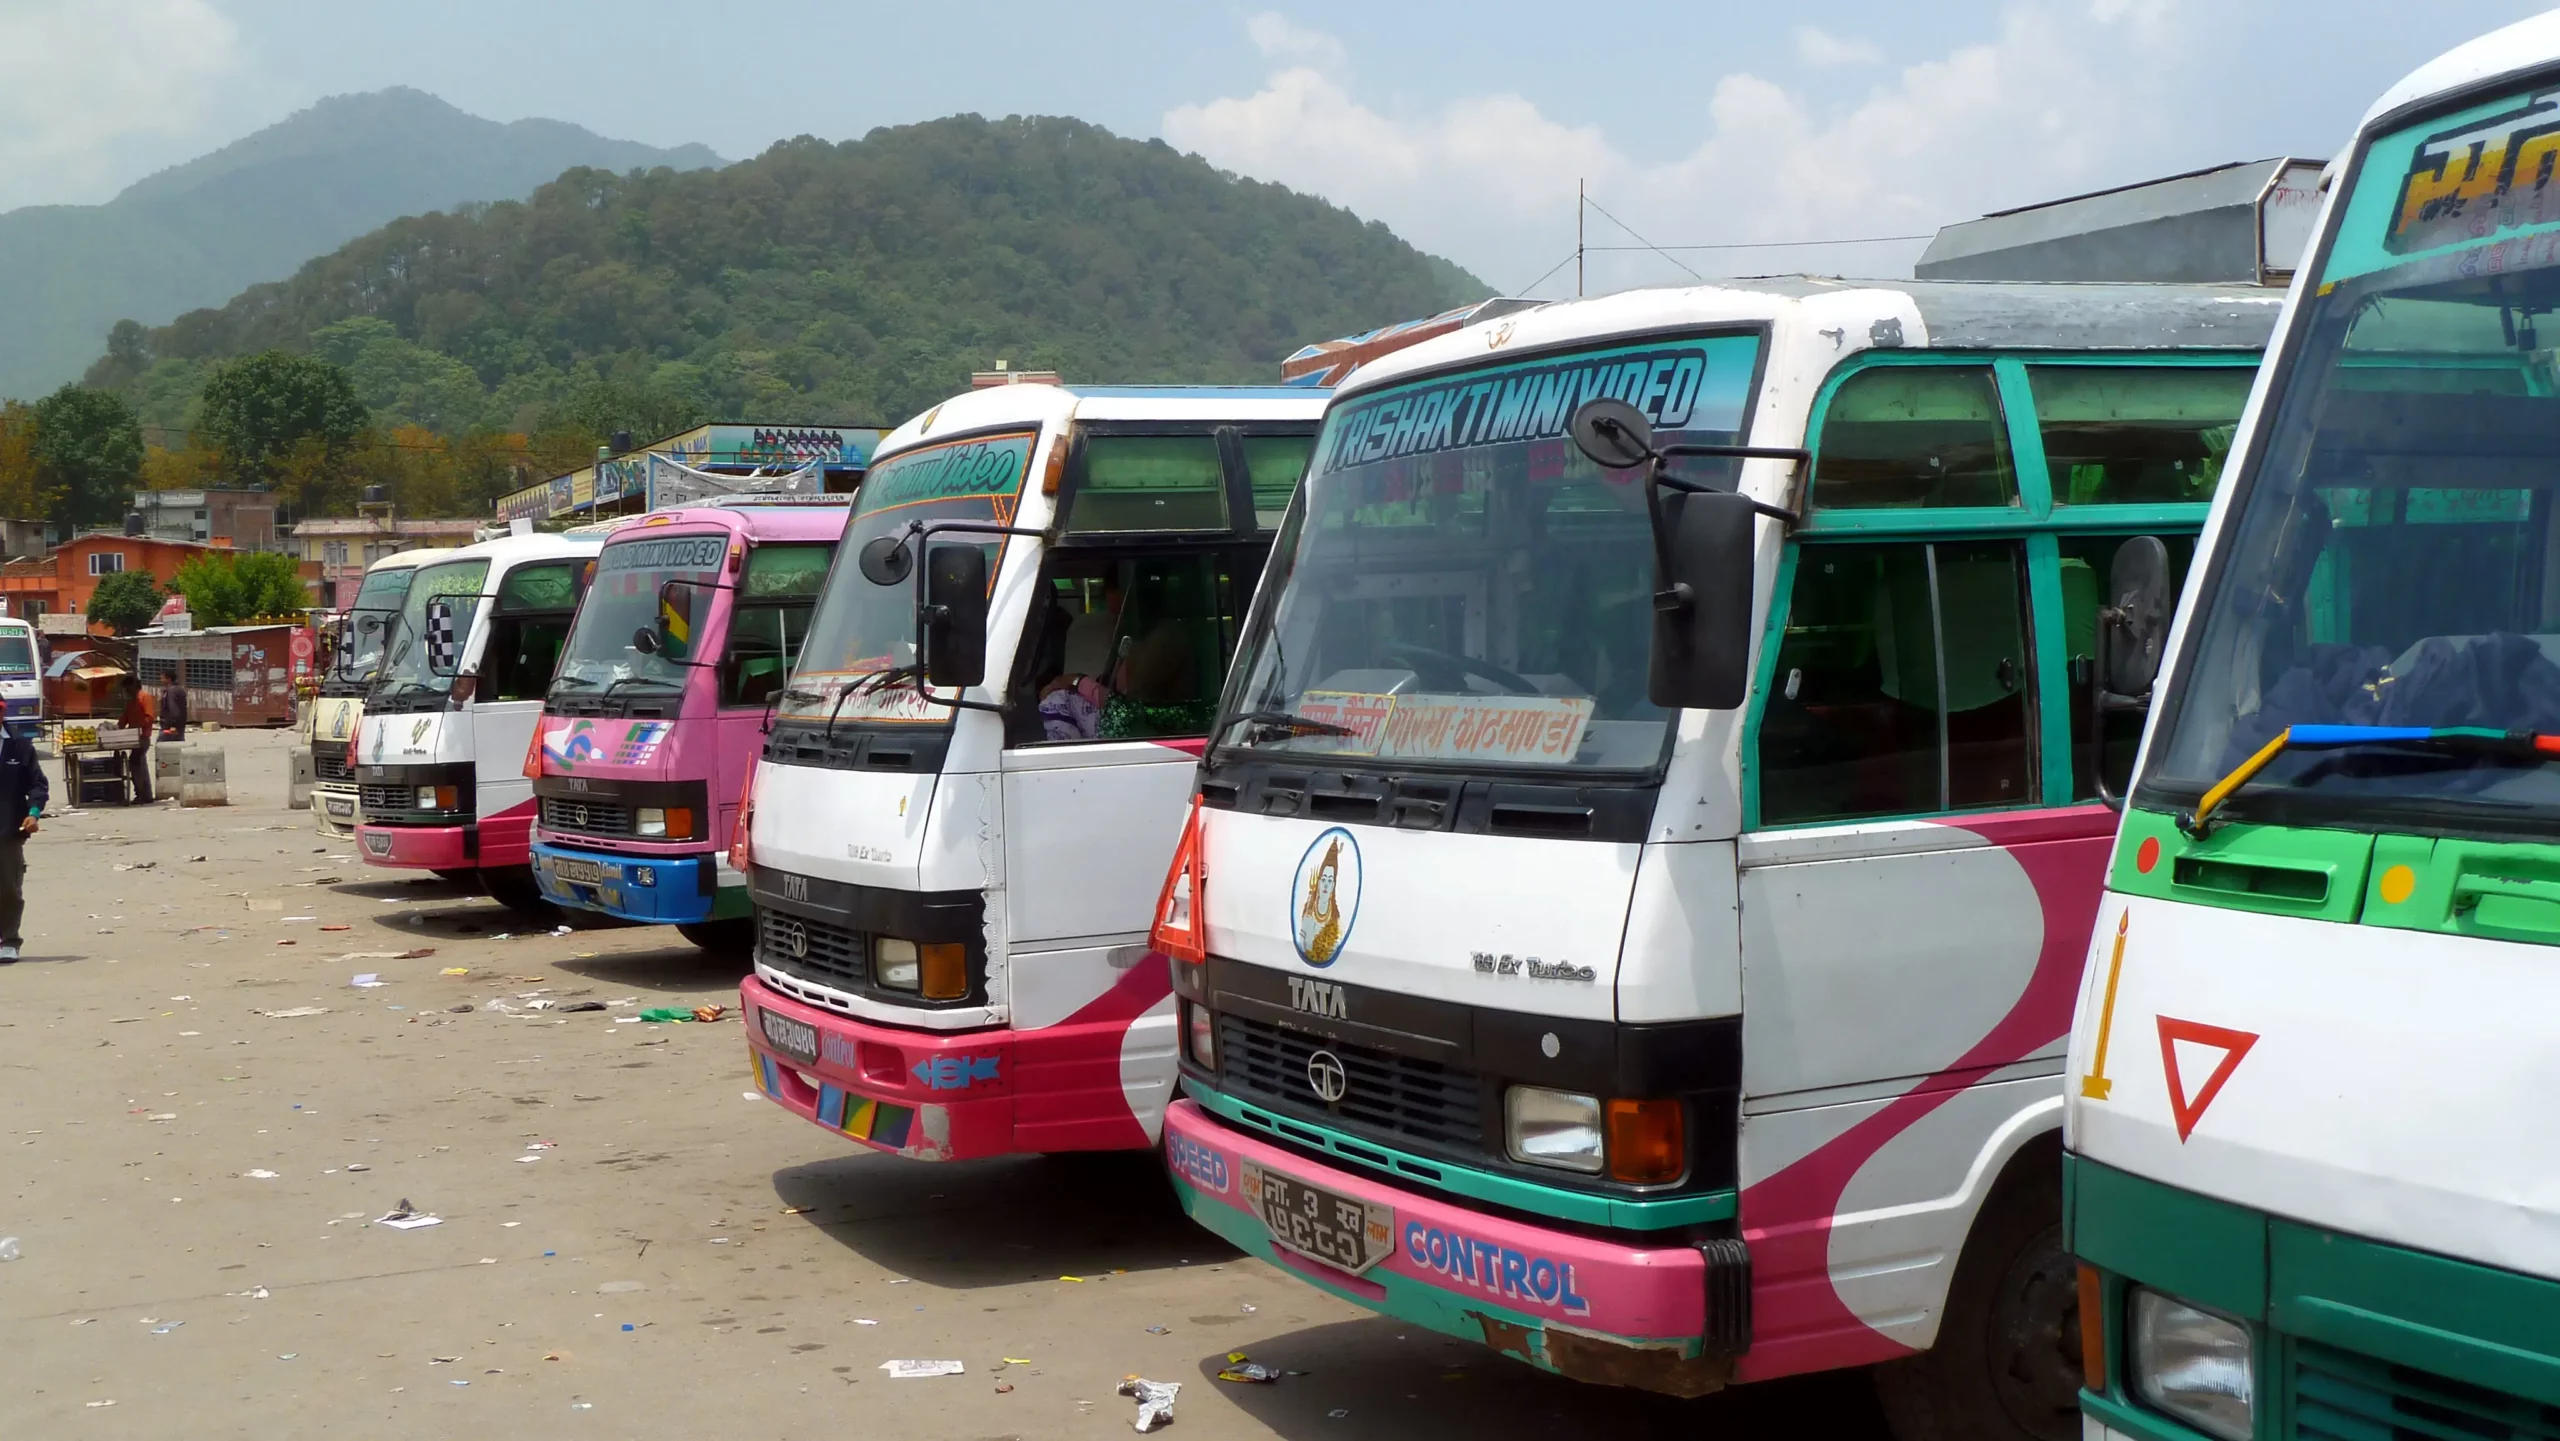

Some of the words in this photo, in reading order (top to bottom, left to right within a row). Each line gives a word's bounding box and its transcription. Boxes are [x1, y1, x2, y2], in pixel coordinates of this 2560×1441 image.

[1324, 377, 1504, 473] TRISHAKTI
[1498, 363, 1583, 443] MINI
[1566, 348, 1708, 430] VIDEO
[930, 443, 1017, 495] Video
[666, 539, 722, 567] VIDEO
[568, 778, 588, 792] TATA
[784, 874, 808, 902] TATA
[1525, 956, 1598, 982] Turbo
[1288, 976, 1352, 1020] TATA
[1167, 1128, 1230, 1195] SPEED
[1405, 1219, 1592, 1318] CONTROL
